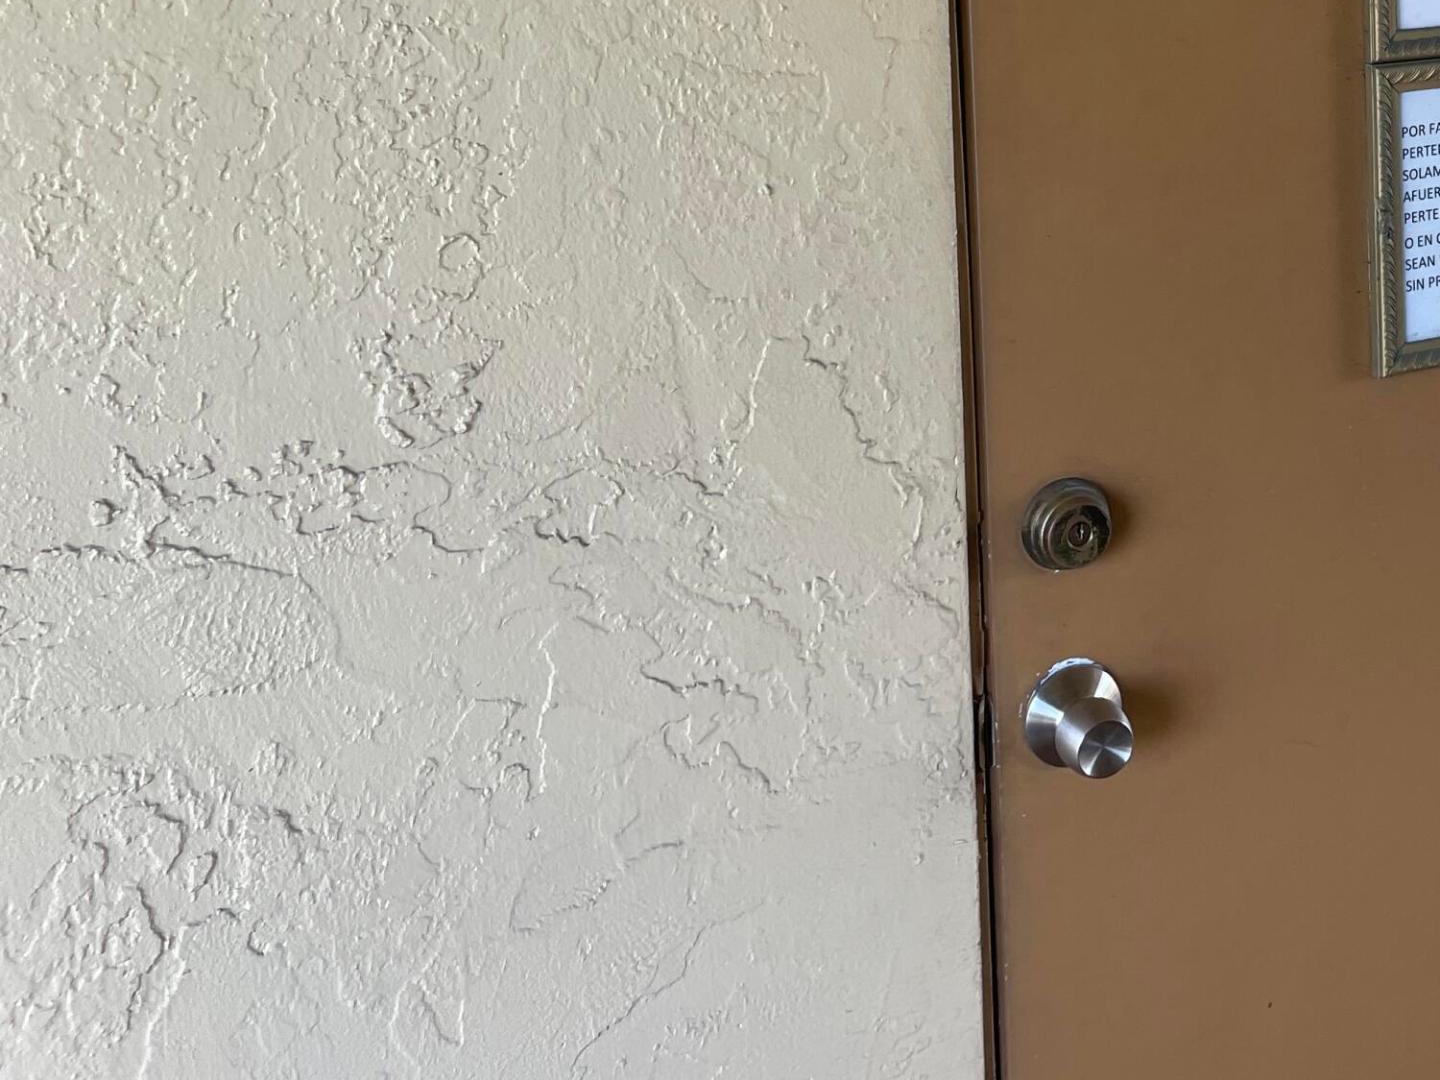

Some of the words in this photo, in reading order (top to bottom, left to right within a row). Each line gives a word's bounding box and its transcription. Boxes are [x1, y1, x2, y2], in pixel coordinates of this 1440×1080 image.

[1402, 125, 1426, 138] POR
[1404, 237, 1413, 249] O
[1418, 234, 1432, 247] EN
[1405, 255, 1435, 271] SEAN
[1406, 279, 1425, 292] SIN
